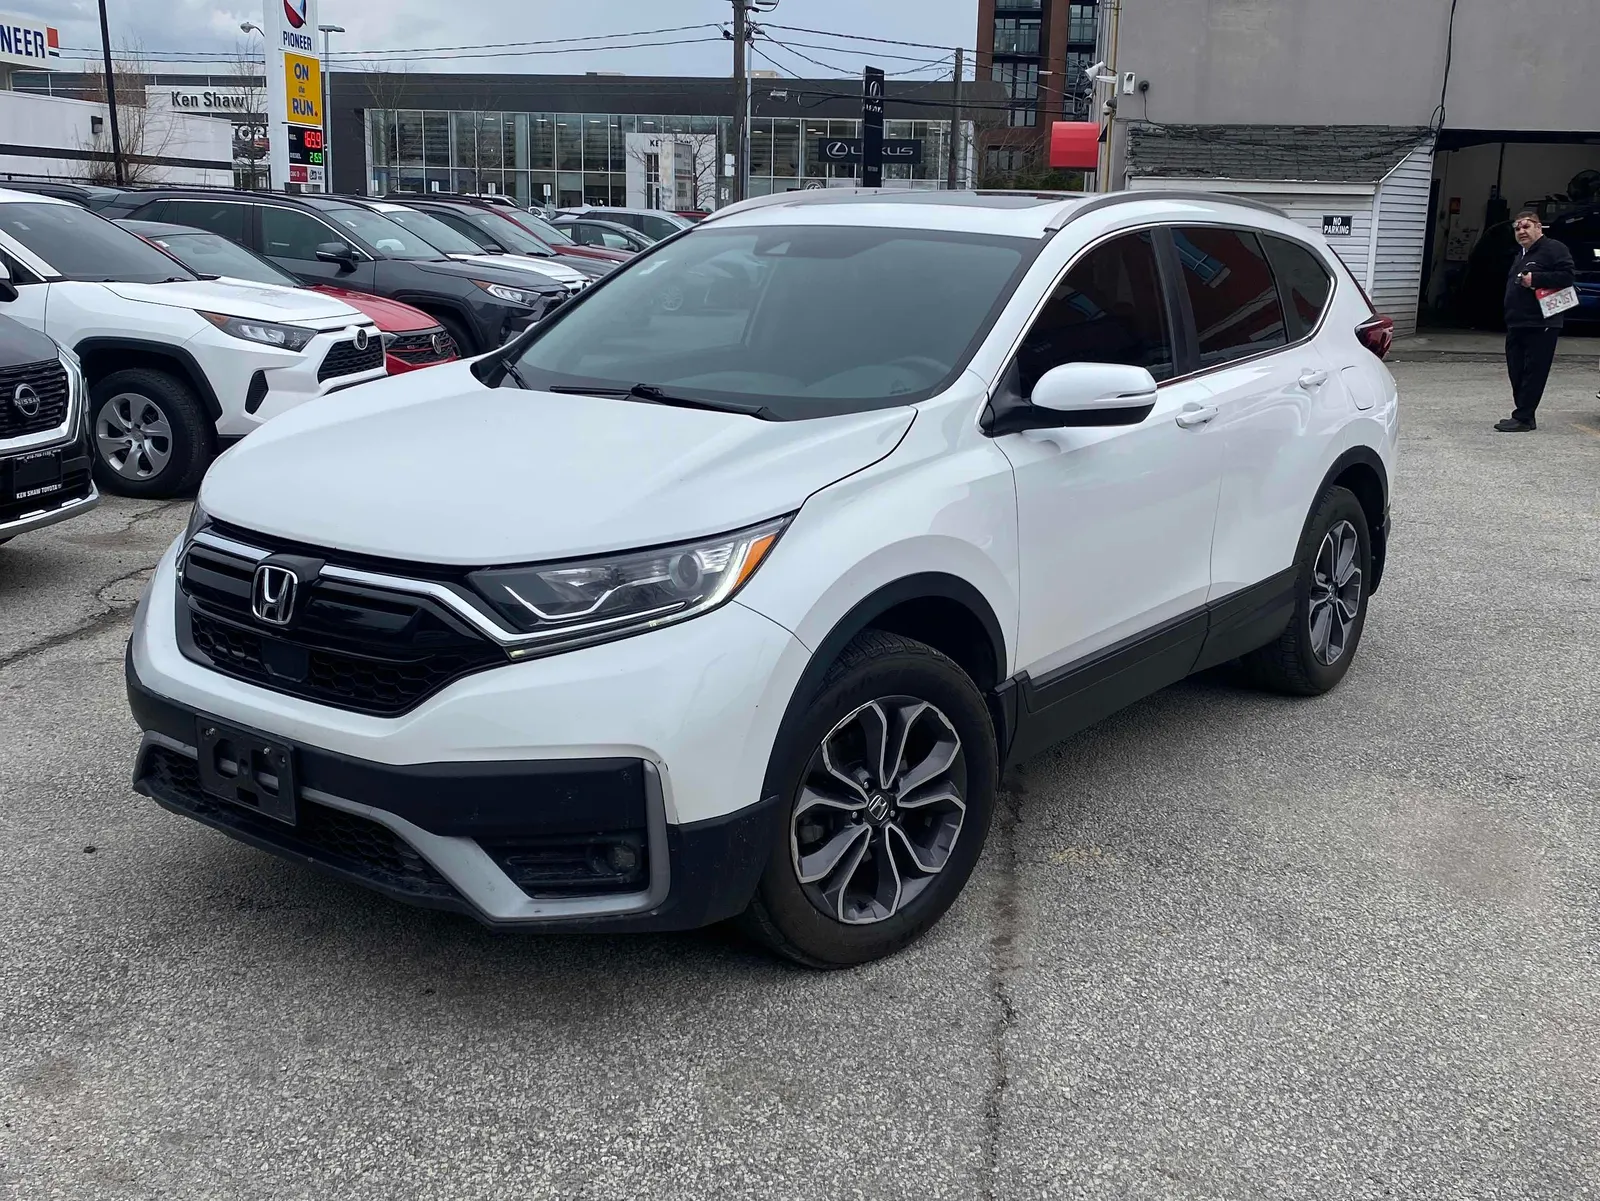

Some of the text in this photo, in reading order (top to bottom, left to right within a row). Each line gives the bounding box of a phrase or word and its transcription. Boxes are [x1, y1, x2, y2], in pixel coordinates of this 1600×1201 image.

[283, 30, 312, 51] PIONEER
[294, 62, 309, 81] ON
[171, 91, 245, 108] Ken Shaw
[850, 146, 914, 156] LXUS
[1332, 216, 1342, 226] NO
[1323, 225, 1350, 235] PARKING
[15, 396, 40, 406] NISSAN
[17, 484, 58, 499] KEN SHAW TOYOTA
